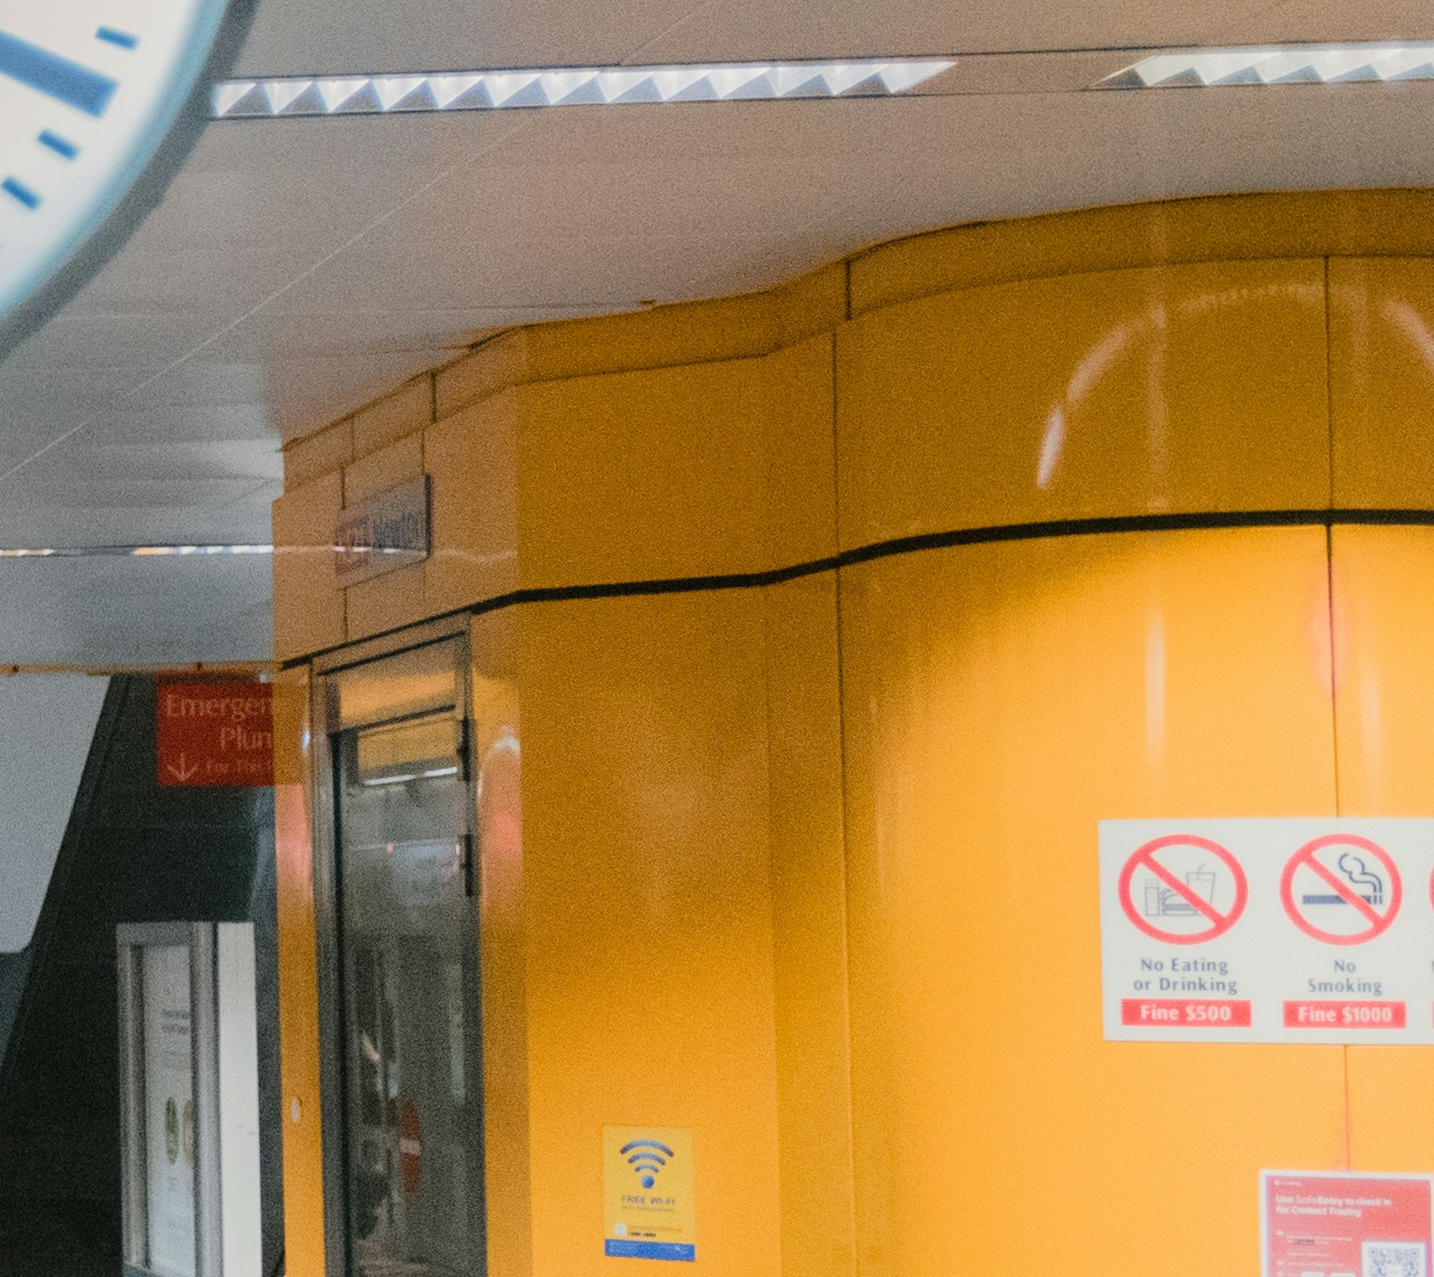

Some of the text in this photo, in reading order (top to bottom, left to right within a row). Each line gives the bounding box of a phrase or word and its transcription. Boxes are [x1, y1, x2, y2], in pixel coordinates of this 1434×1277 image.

[1141, 957, 1229, 975] No Eating
[1334, 959, 1357, 973] No
[1133, 977, 1238, 995] or Drinking
[1307, 977, 1383, 996] Smoking
[1140, 1004, 1232, 1022] Fine $500
[1298, 1006, 1393, 1024] Fine $1000
